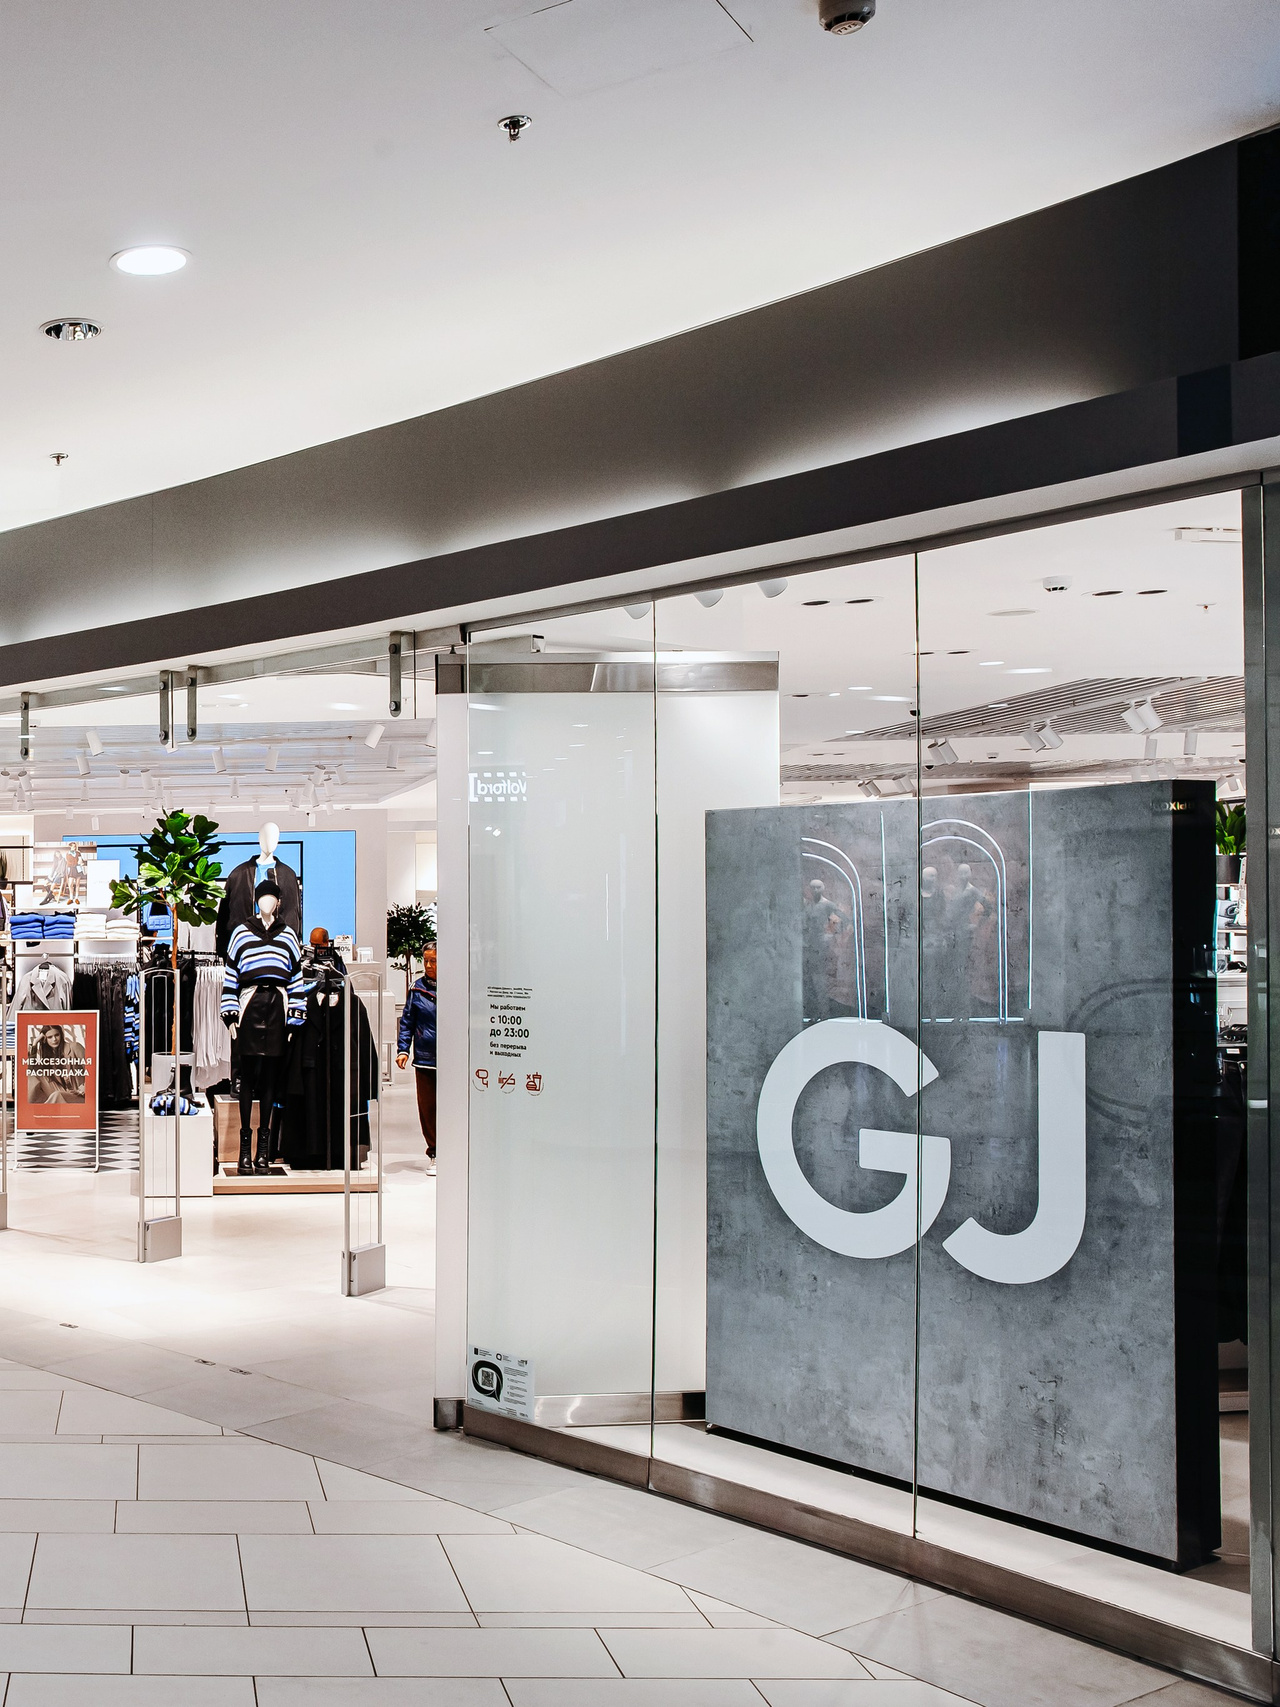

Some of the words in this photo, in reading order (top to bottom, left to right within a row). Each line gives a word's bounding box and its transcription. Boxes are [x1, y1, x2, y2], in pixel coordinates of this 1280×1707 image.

[490, 1016, 496, 1024] с
[498, 1015, 522, 1025] 10:00
[489, 1028, 502, 1038] до
[504, 1027, 530, 1039] 23:00
[494, 1050, 522, 1058] выходных
[22, 1057, 92, 1066] МЕЖСЕЗОННАЯ
[25, 1068, 90, 1077] РАСПРОДАЖА
[756, 1016, 1087, 1285] GJ
